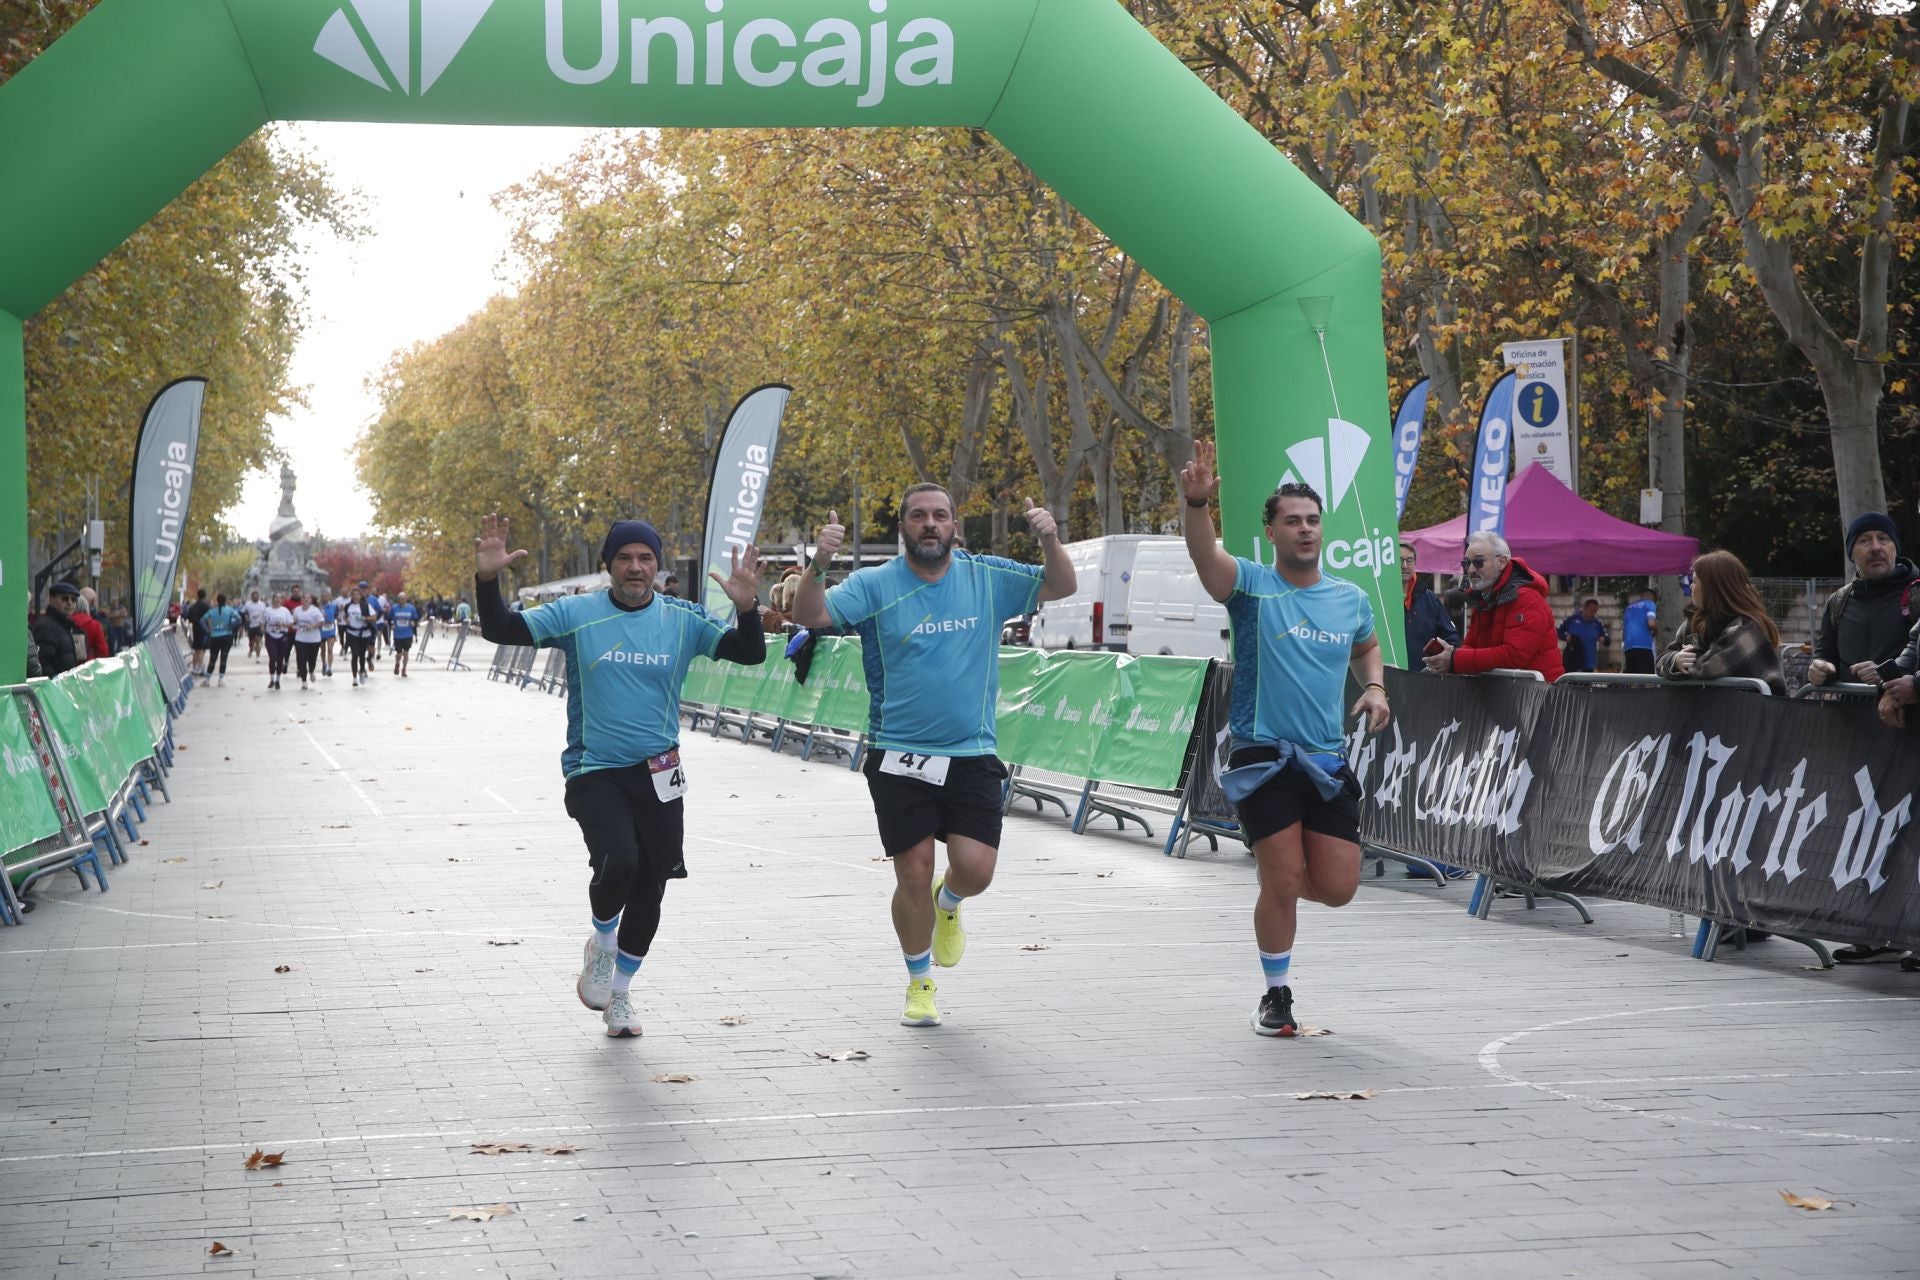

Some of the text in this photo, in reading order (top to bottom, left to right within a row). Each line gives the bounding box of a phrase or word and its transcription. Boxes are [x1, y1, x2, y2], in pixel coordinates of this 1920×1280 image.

[545, 0, 955, 107] Unicaja
[1511, 349, 1547, 359] Oficina de
[154, 441, 192, 564] Unicaja
[722, 444, 770, 560] Unicaja
[1480, 417, 1507, 531] VECO
[911, 616, 979, 635] ADIENT
[1288, 625, 1350, 646] ADIENT
[598, 650, 671, 667] ADIENT
[899, 752, 932, 771] 47
[1588, 731, 1912, 895] El Norte de
